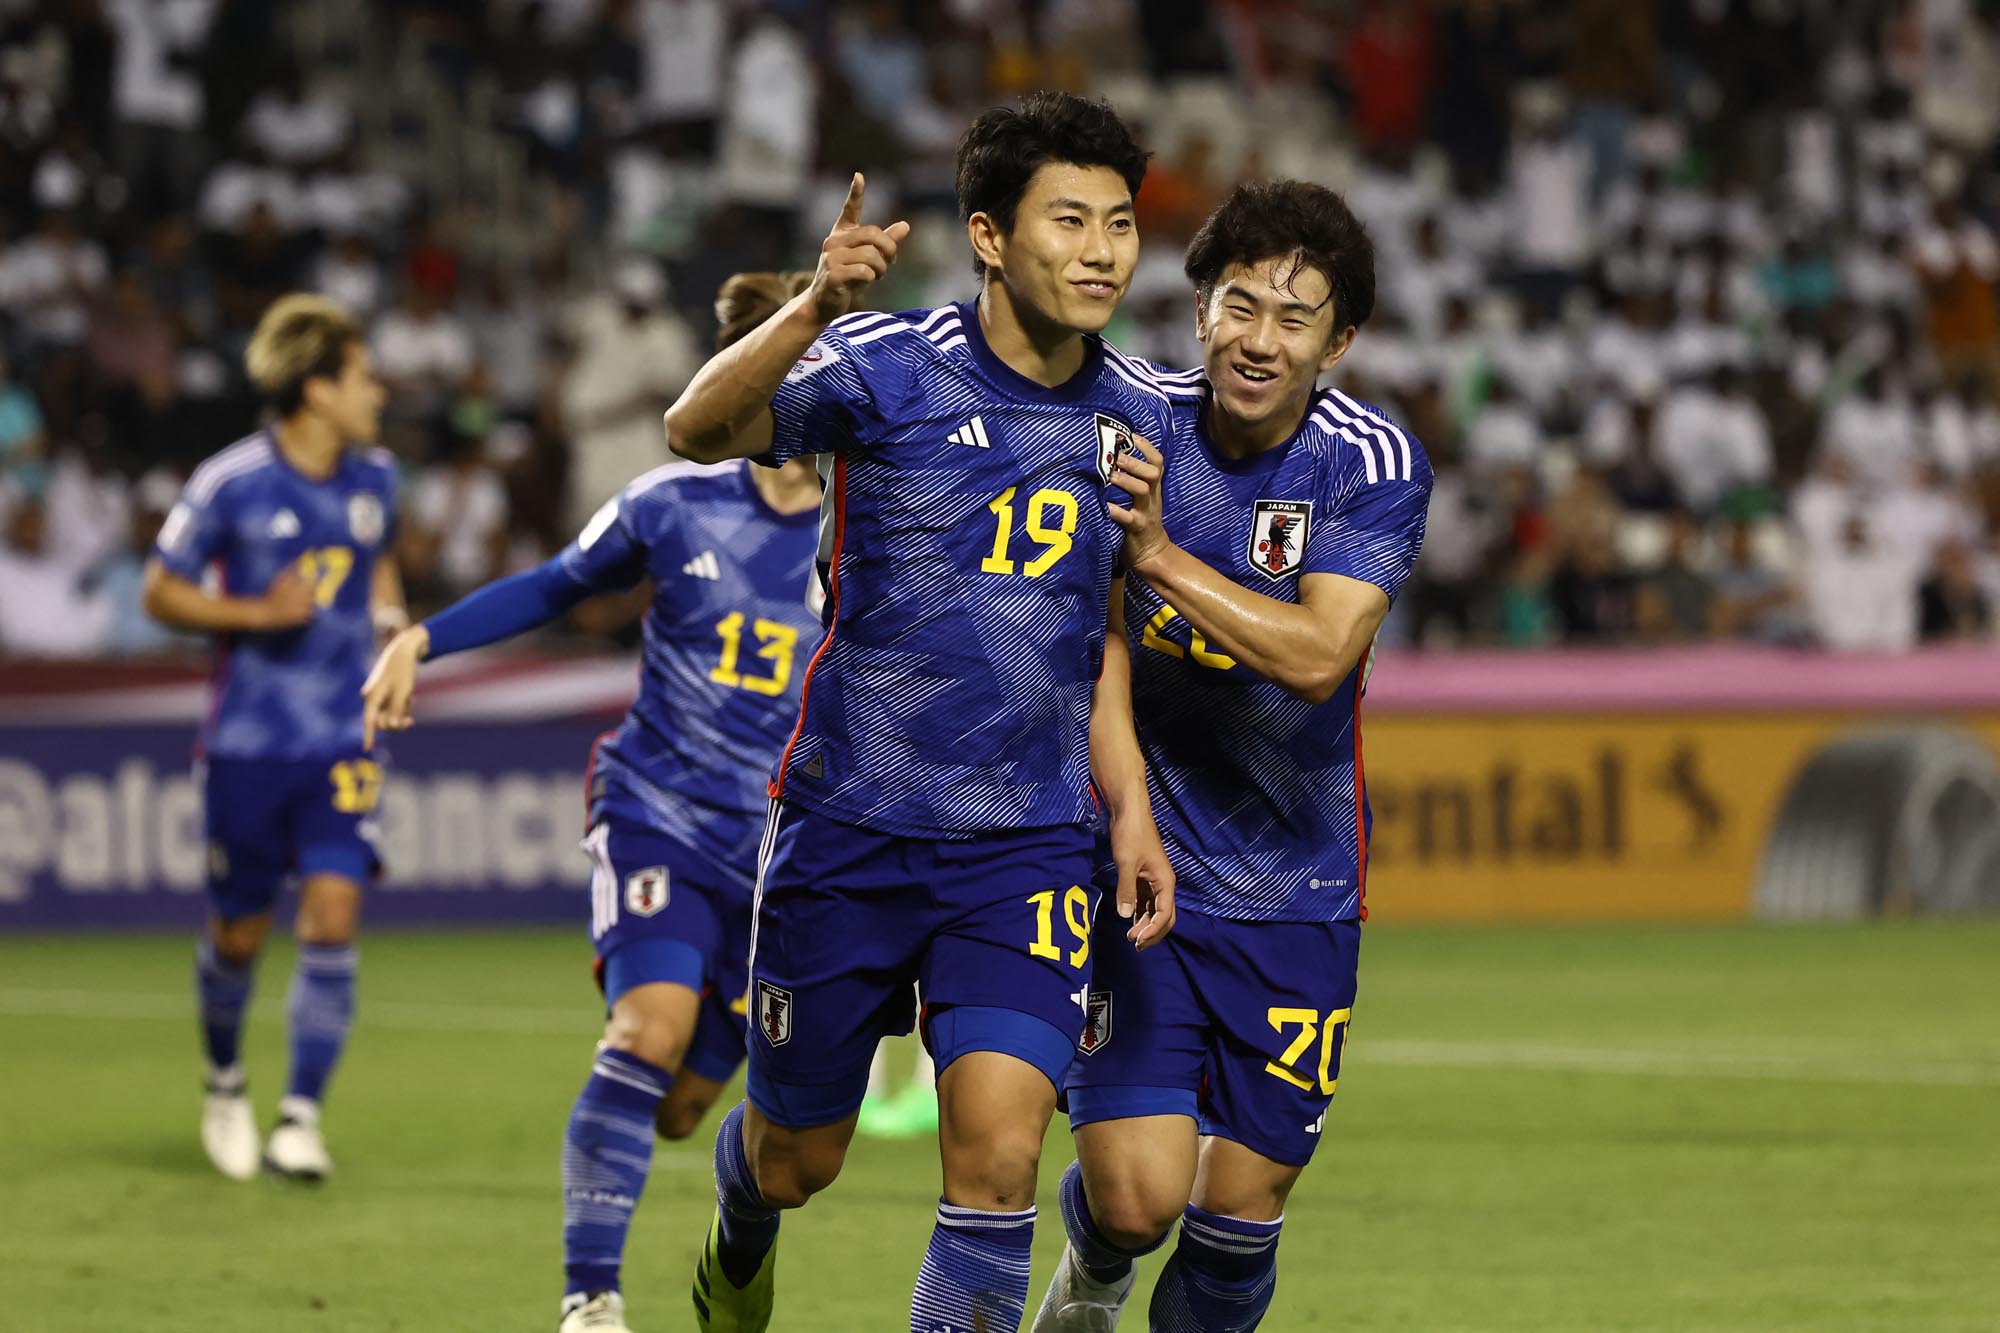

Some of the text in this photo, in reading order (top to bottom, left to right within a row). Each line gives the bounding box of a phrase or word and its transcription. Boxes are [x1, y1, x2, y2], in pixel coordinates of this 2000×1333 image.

[981, 486, 1079, 577] 19
[1266, 503, 1297, 511] JAPAN
[710, 611, 799, 698] 13
[1025, 884, 1092, 970] 19
[1264, 1006, 1351, 1096] 20
